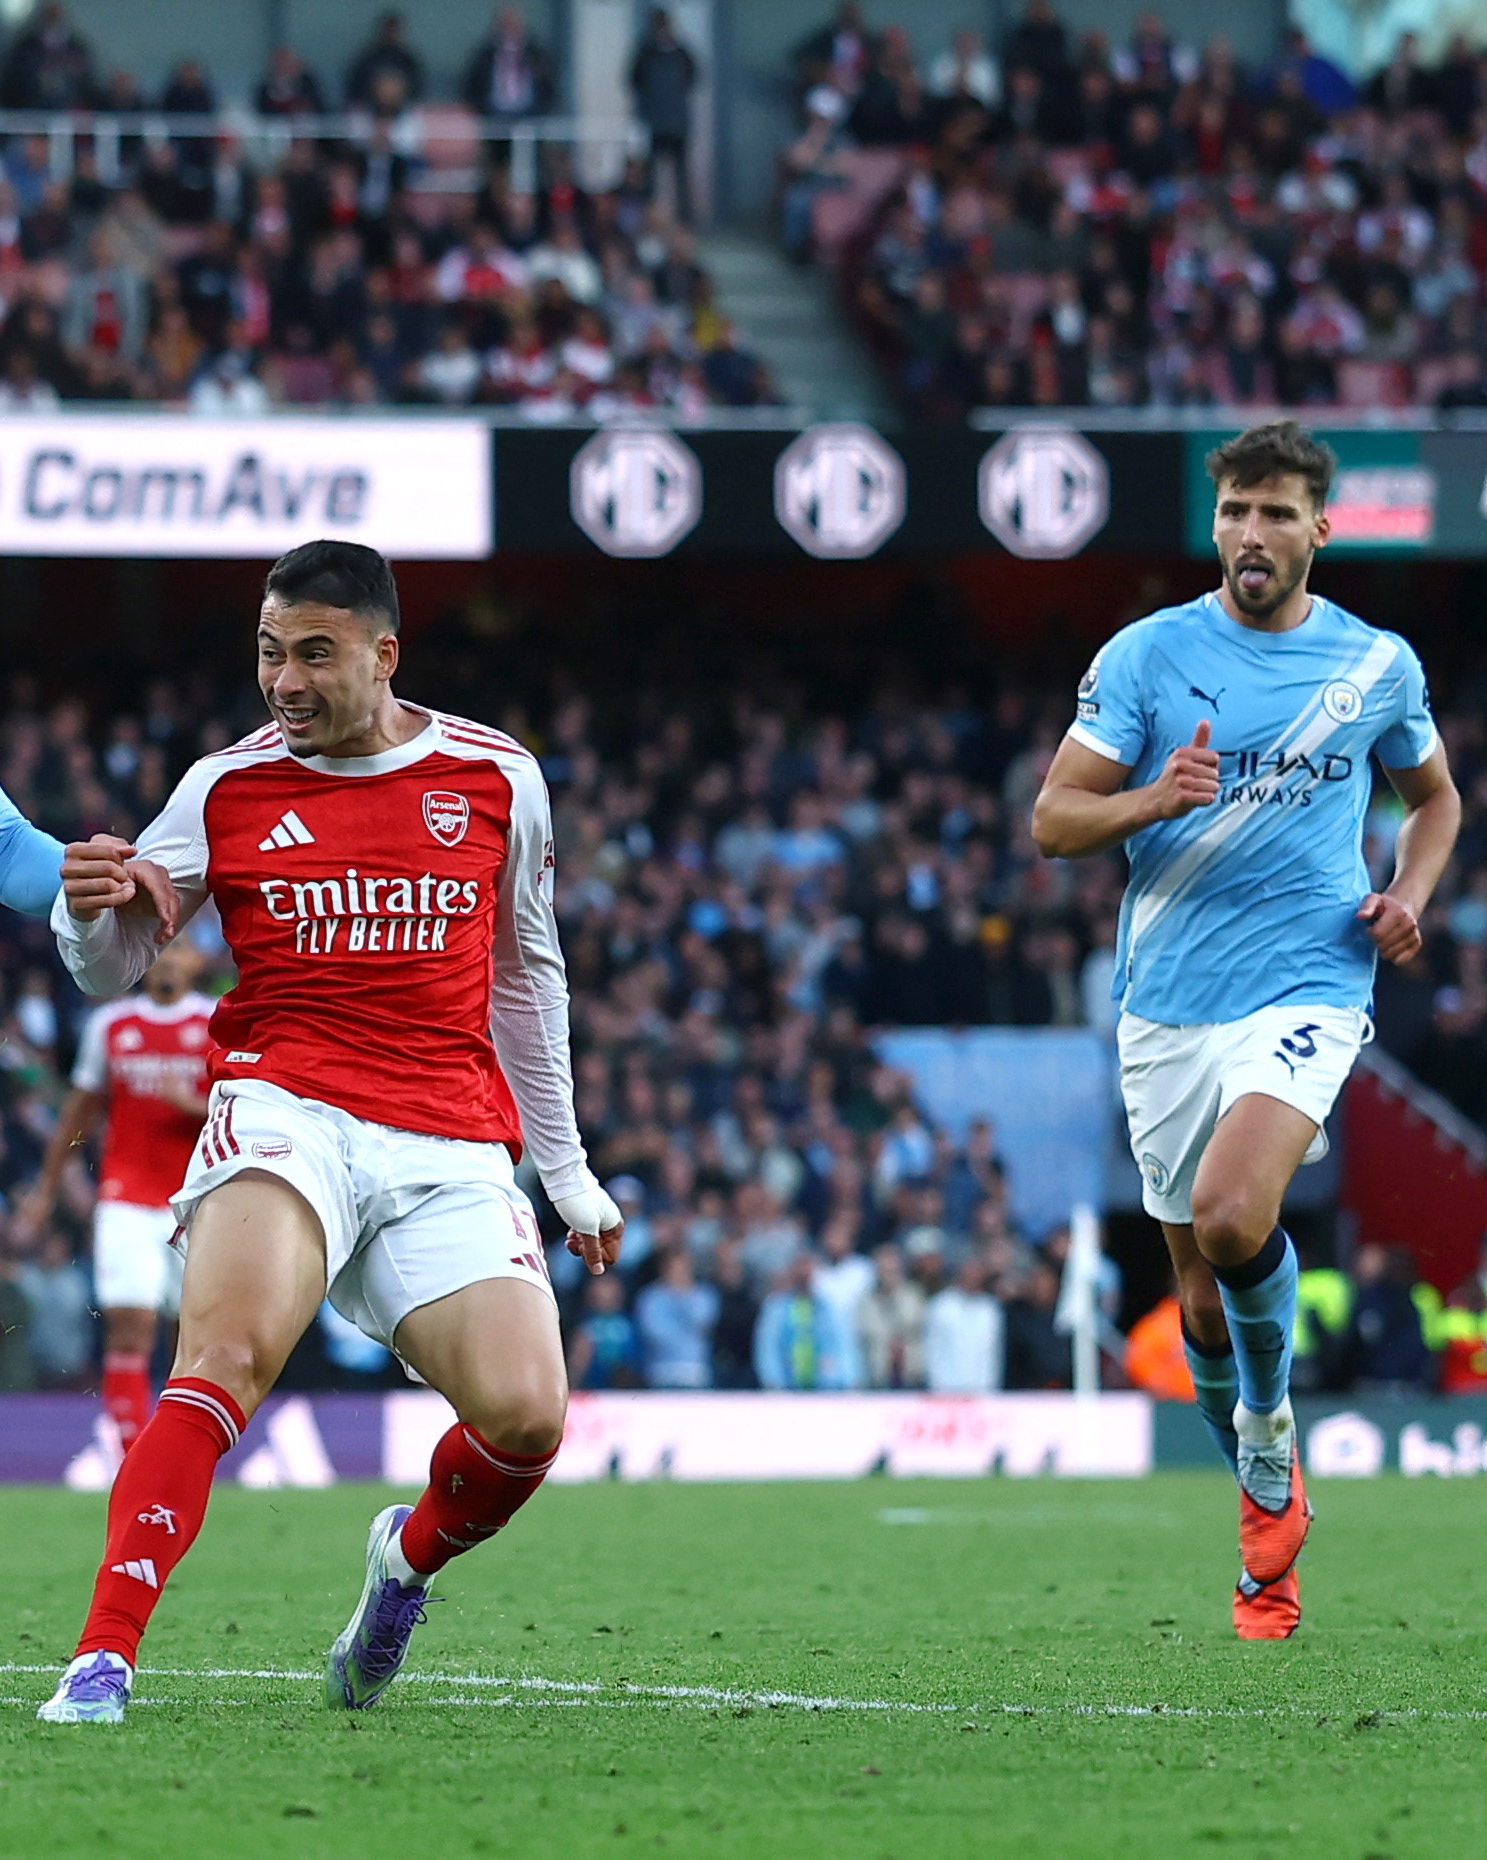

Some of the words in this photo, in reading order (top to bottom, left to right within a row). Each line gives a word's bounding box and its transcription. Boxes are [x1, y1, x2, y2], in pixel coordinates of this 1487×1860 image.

[25, 446, 372, 525] ComAve
[576, 440, 696, 548] MG
[780, 440, 900, 548] MG
[984, 440, 1104, 548] MG
[1218, 751, 1352, 782] IHAD
[430, 799, 463, 811] Arsenal
[1220, 785, 1313, 807] IRWAYS
[259, 868, 479, 921] Emirates
[296, 919, 339, 954] FLY
[348, 916, 449, 951] BETTER
[1280, 1023, 1322, 1058] 3
